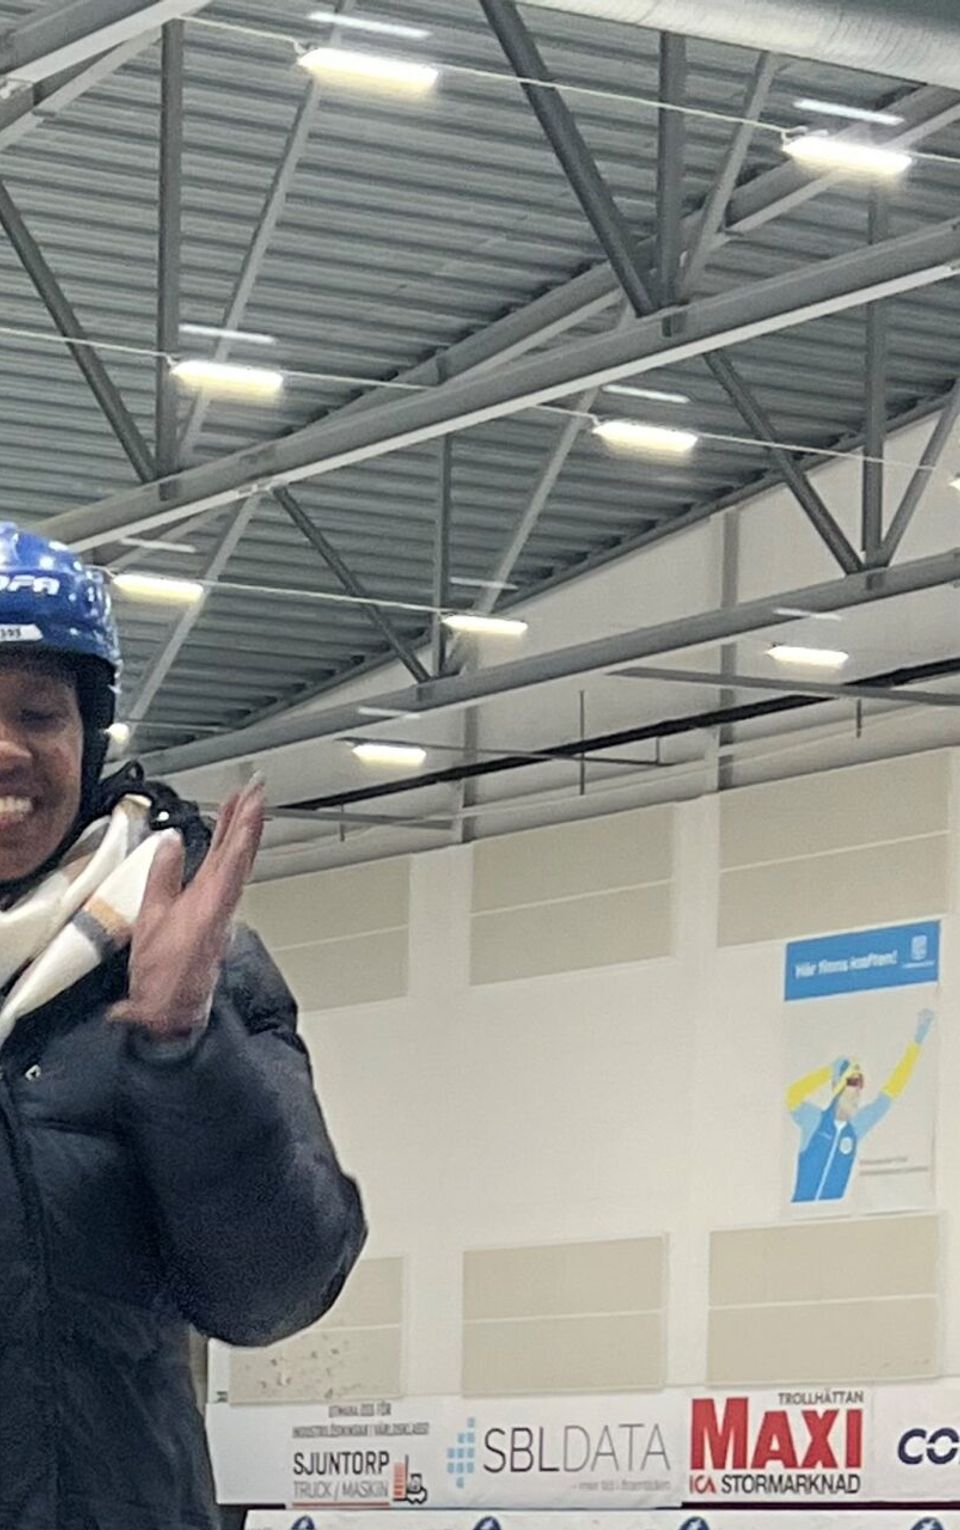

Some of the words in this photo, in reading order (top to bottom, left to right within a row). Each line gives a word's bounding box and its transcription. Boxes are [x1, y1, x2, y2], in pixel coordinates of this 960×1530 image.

[778, 1389, 863, 1405] TROLLHÄTTAN
[690, 1397, 863, 1470] MAXI
[483, 1423, 671, 1473] SBLDATA
[293, 1451, 390, 1476] SJUNTORP
[293, 1481, 333, 1499] TRUCK
[342, 1481, 388, 1498] MASKIN
[689, 1475, 716, 1494] ICA
[721, 1474, 861, 1494] STORMARKNAD
